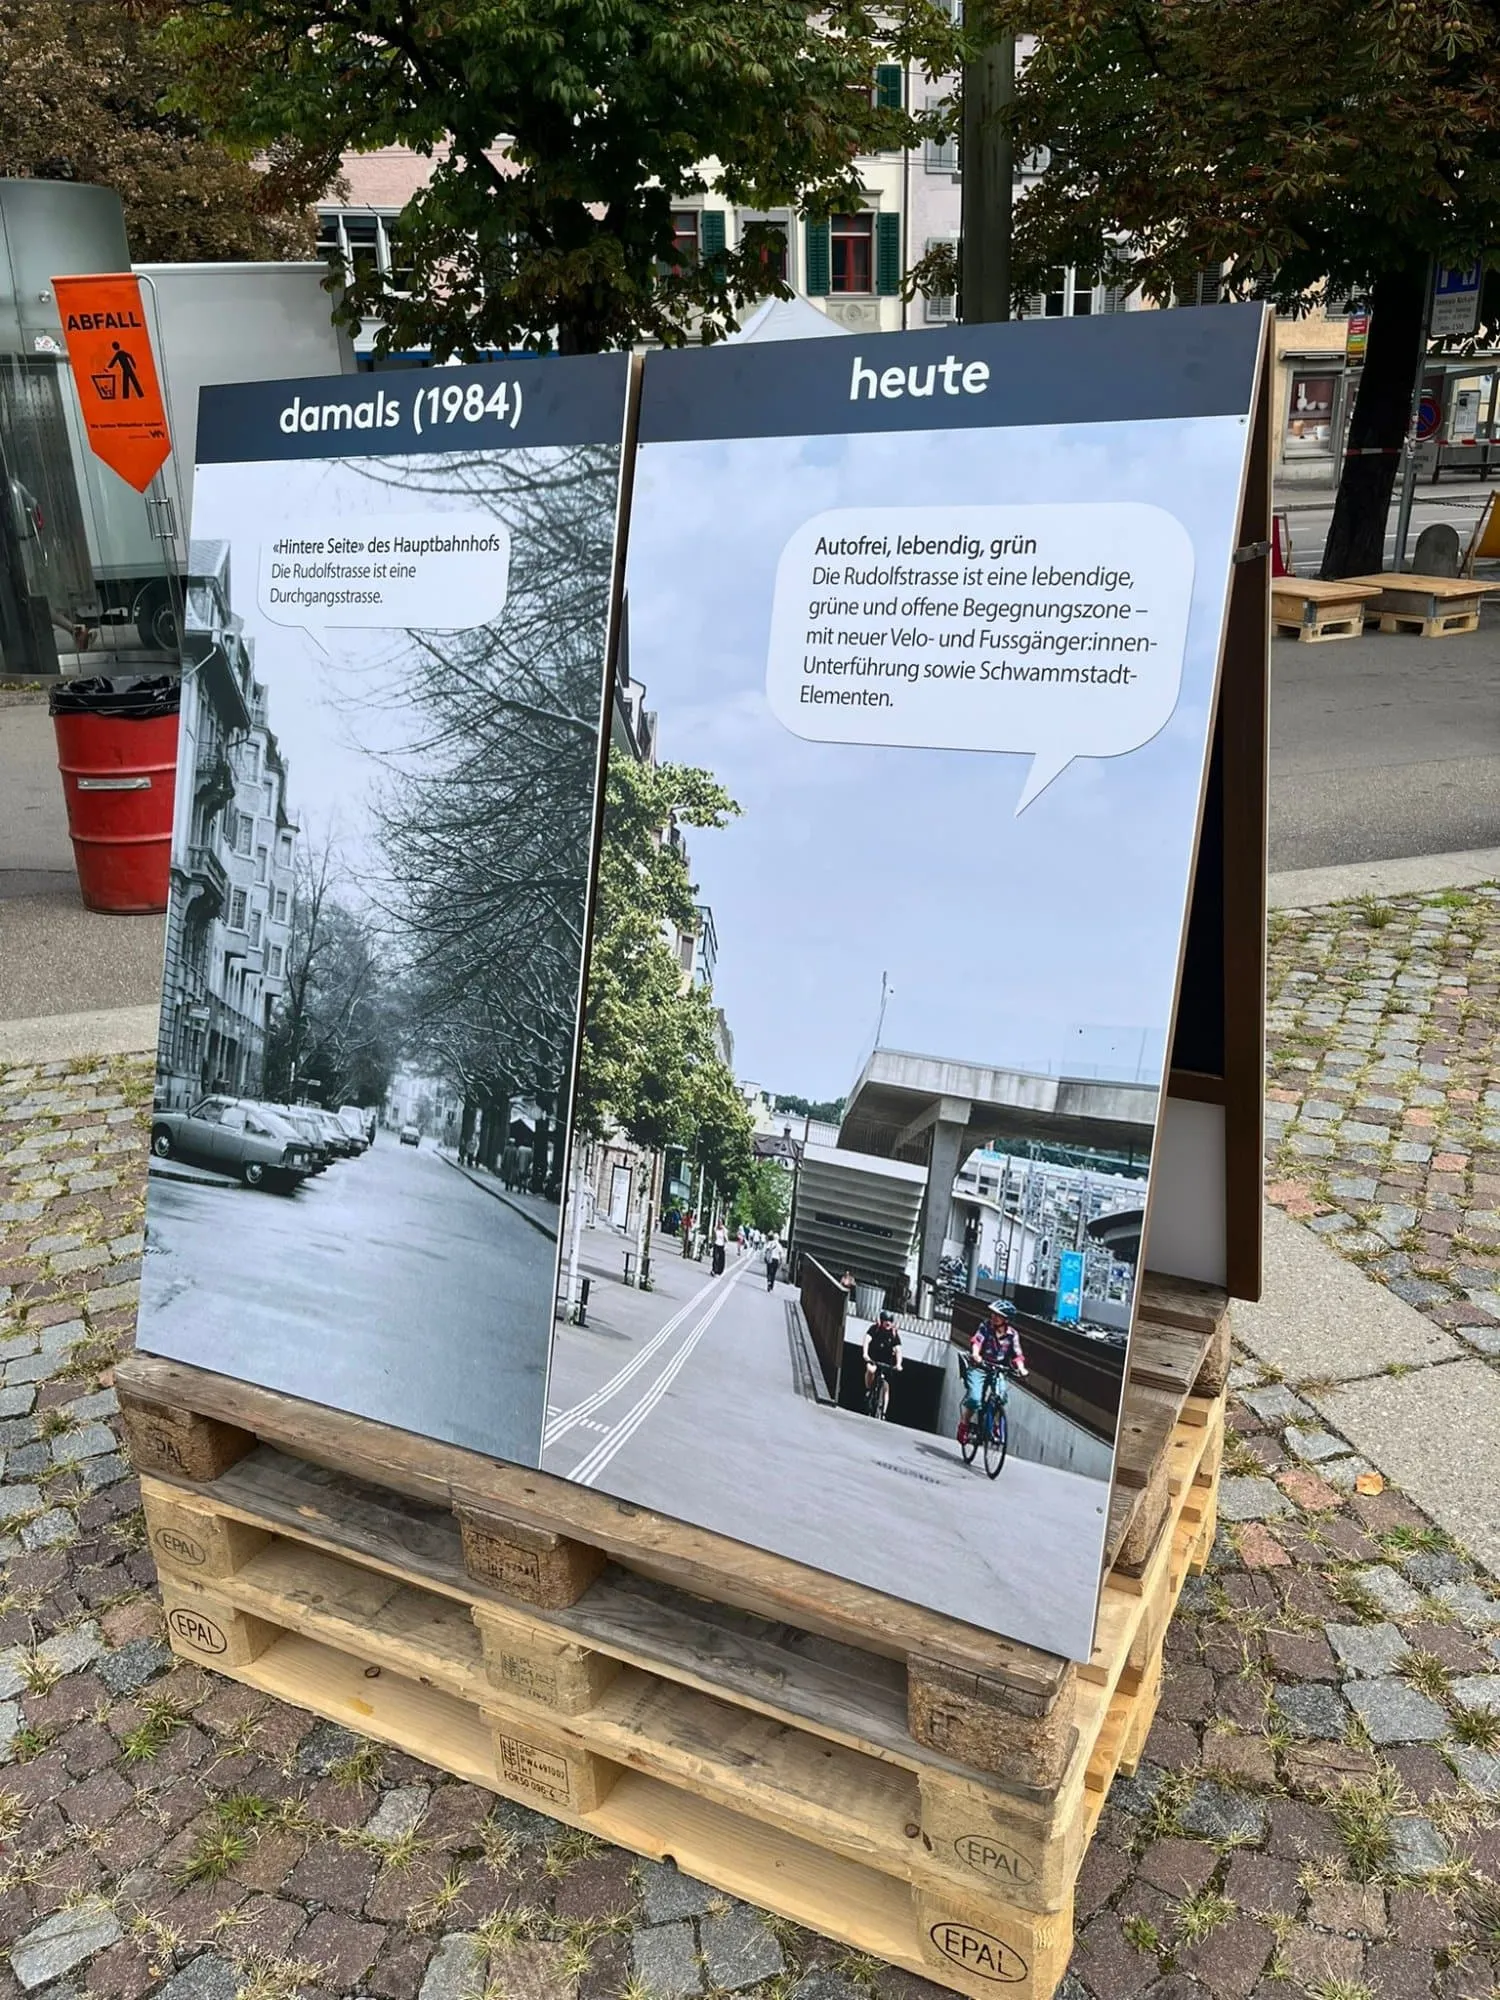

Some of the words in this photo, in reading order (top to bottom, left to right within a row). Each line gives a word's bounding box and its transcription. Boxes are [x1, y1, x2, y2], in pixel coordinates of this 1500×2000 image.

[68, 312, 141, 331] ABFALL
[849, 355, 990, 401] heute
[279, 390, 400, 434] damals
[413, 381, 523, 435] (1984)
[272, 538, 325, 555] «Hintere
[326, 537, 365, 554] Seite»
[367, 536, 391, 554] des
[393, 533, 501, 557] Hauptbahnhofs
[814, 534, 892, 559] Autofrei,
[896, 533, 985, 561] lebendig,
[989, 534, 1038, 561] grün
[271, 563, 292, 579] Die
[292, 561, 371, 579] Rudolfstrasse
[372, 562, 388, 579] ist
[389, 562, 417, 579] eine
[812, 566, 841, 586] Die
[843, 565, 959, 587] Rudolfstrasse
[962, 566, 985, 586] ist
[986, 566, 1029, 587] eine
[1031, 565, 1135, 592] lebendige,
[269, 587, 383, 608] Durchgangsstrasse.
[808, 596, 860, 620] grüne
[862, 596, 899, 617] und
[900, 596, 960, 618] offene
[962, 597, 1132, 624] Begegnungszone
[805, 626, 835, 646] mit
[837, 627, 889, 648] neuer
[890, 626, 935, 649] Velo-
[938, 628, 976, 650] und
[978, 629, 1158, 656] Fussgänger:innen-
[803, 655, 920, 683] Unterführung
[923, 660, 976, 681] sowie
[979, 659, 1138, 686] Schwammstadt-
[799, 684, 894, 709] Elementen.
[162, 1532, 202, 1561] EPAL
[176, 1613, 221, 1649] EPAL
[968, 1840, 1028, 1884] EPAL
[944, 1927, 1014, 1979] EPAL
